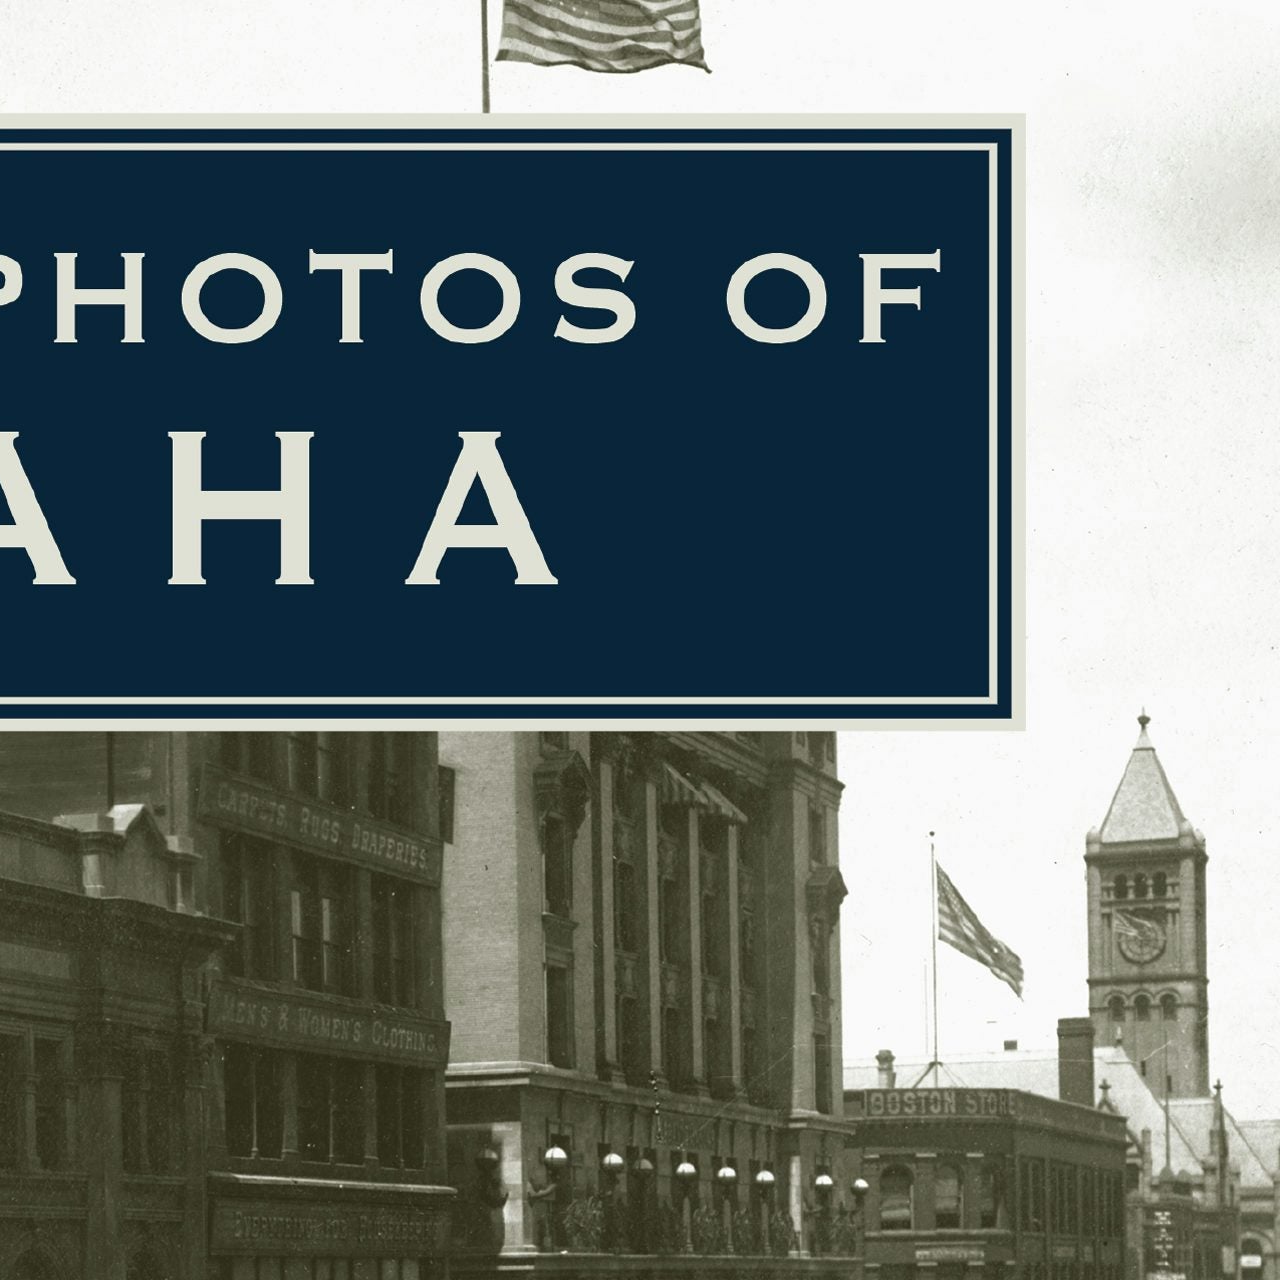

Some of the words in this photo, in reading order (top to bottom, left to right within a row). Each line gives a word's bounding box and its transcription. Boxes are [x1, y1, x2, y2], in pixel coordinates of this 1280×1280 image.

[278, 1003, 290, 1032] &
[870, 1090, 957, 1115] BOSTON
[965, 1090, 1017, 1116] STORE
